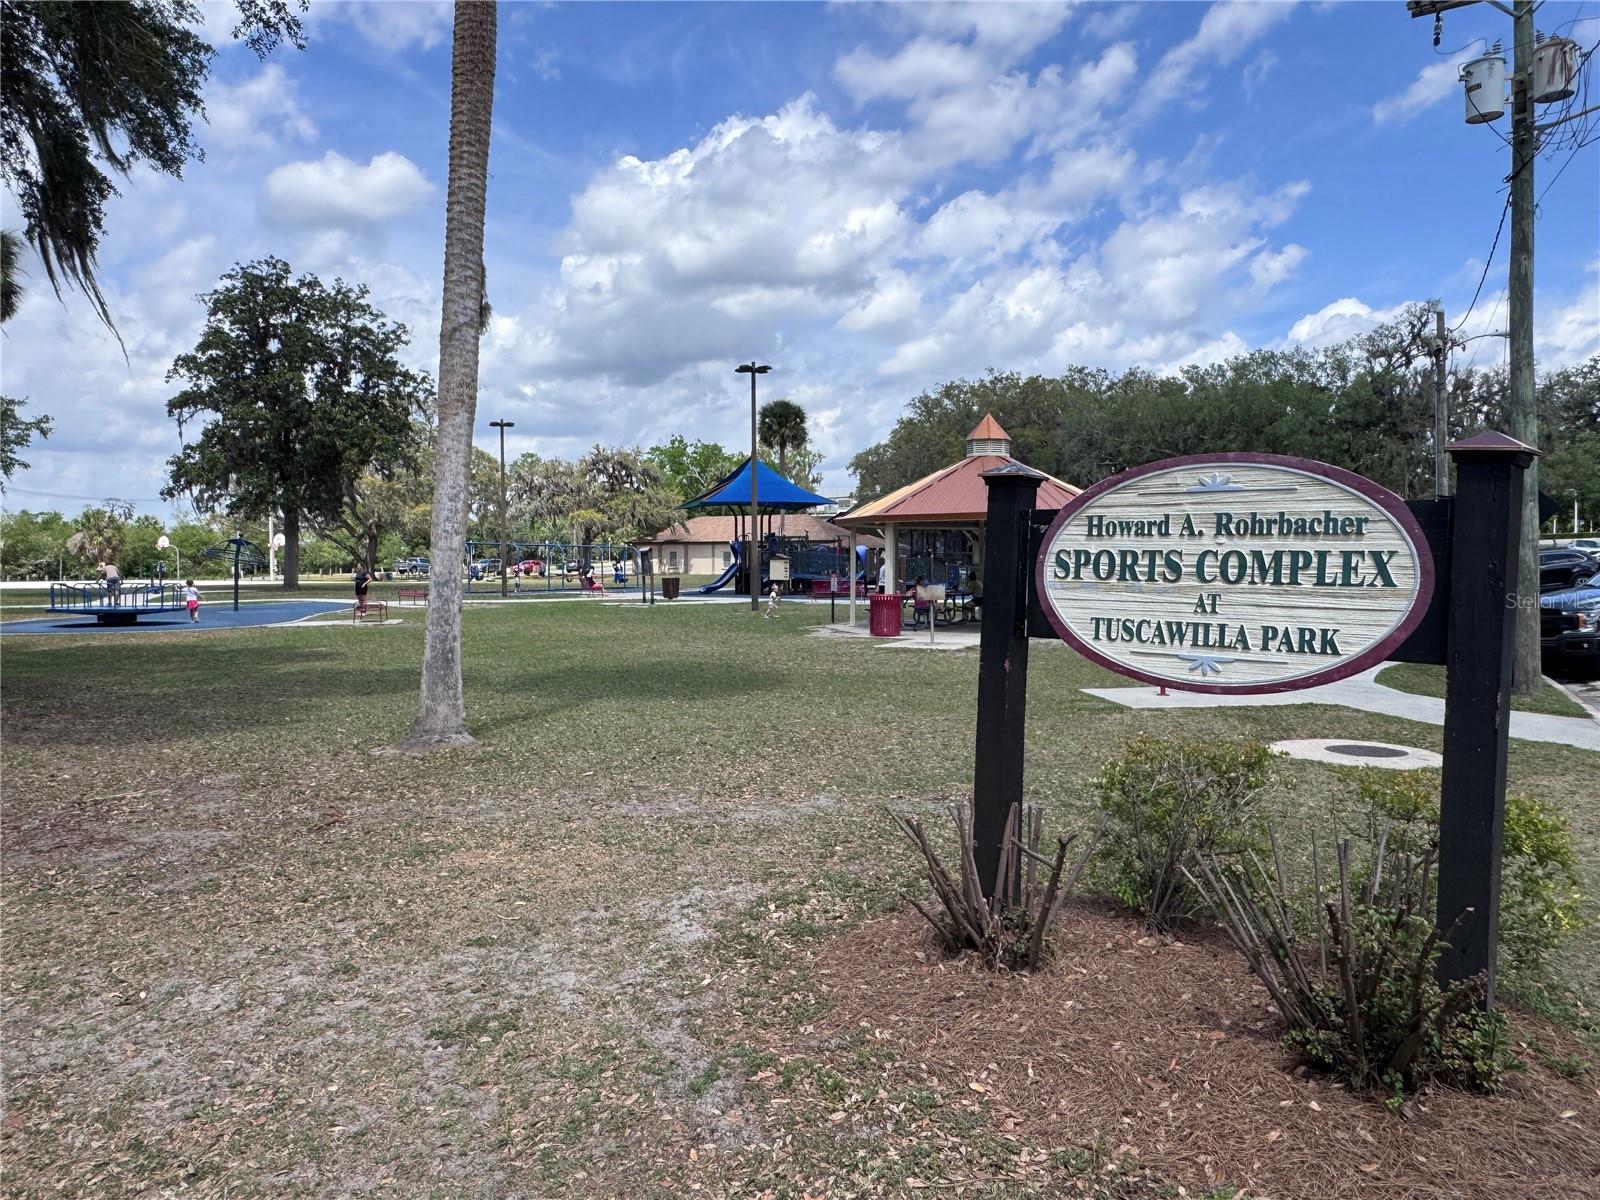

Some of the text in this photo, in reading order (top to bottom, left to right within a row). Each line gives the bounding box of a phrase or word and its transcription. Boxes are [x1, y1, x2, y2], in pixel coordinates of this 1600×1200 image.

[1086, 511, 1369, 538] Howard A. Rohrbacher
[1054, 549, 1398, 588] SPORTS COMPLEX
[1193, 593, 1222, 614] AT
[1090, 617, 1342, 656] TUSCAWILLA PARK
